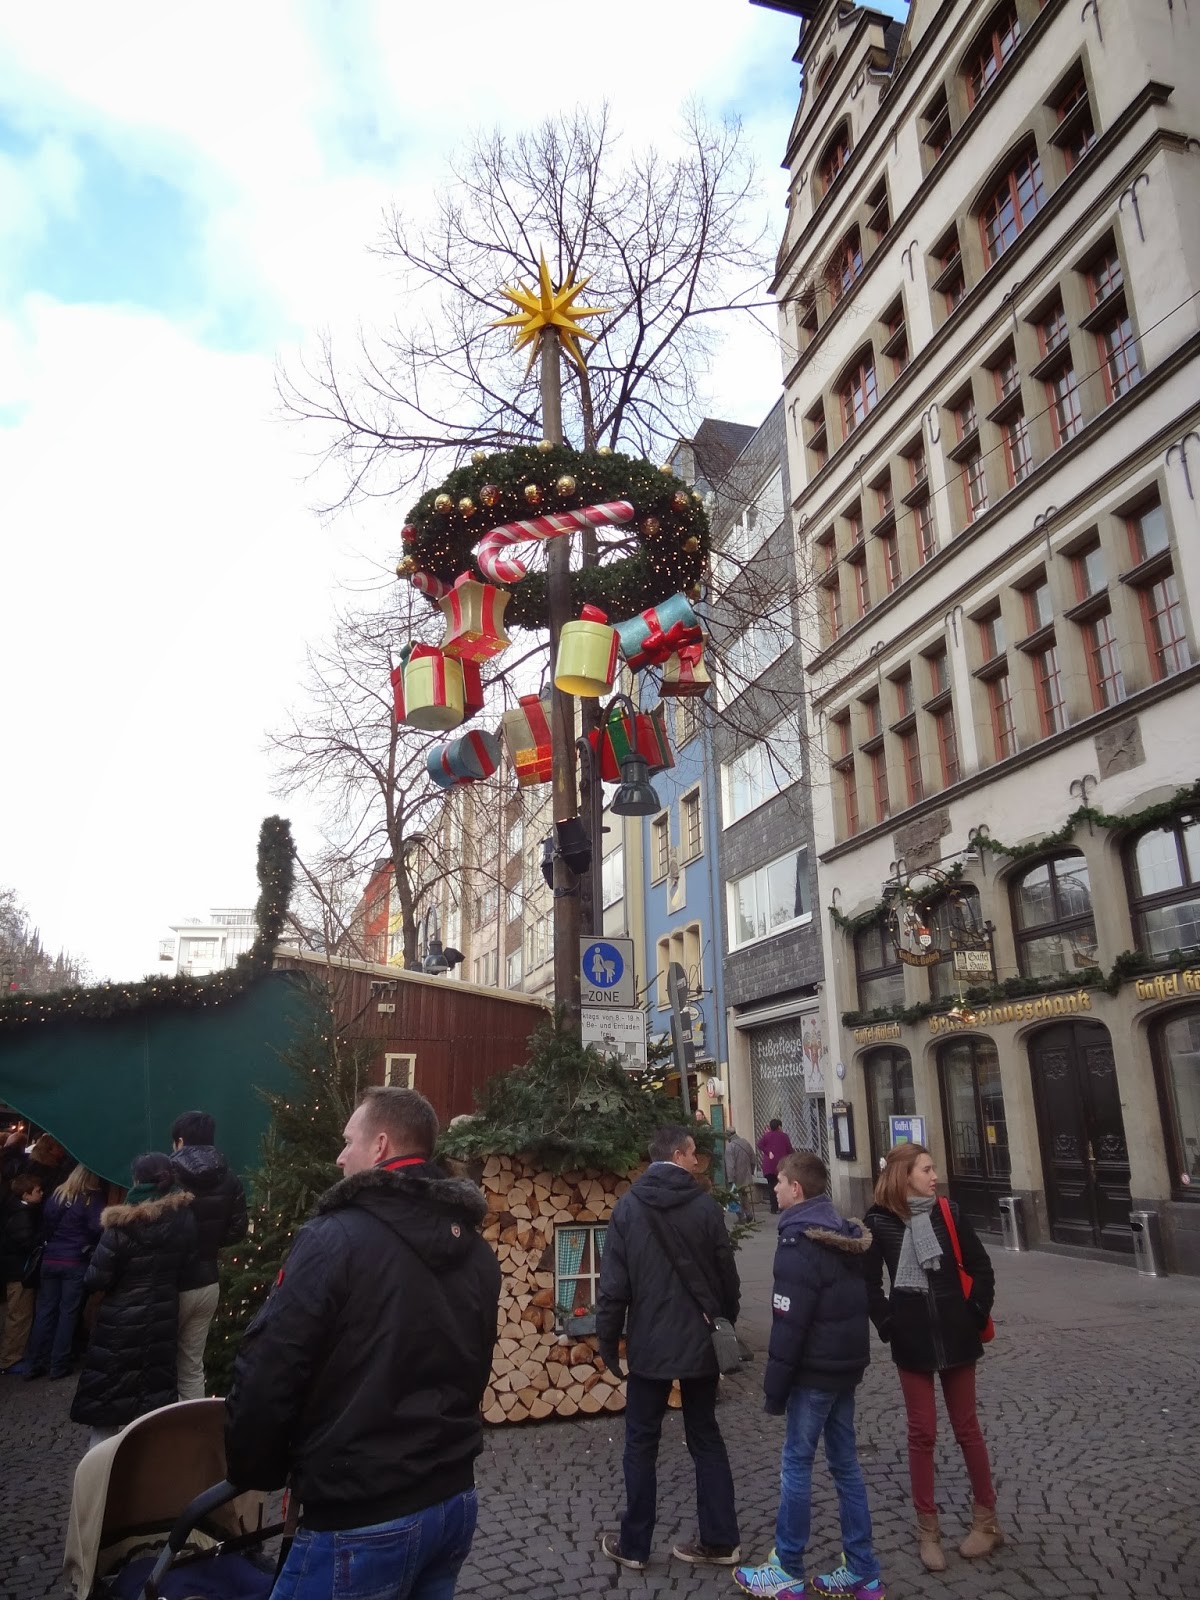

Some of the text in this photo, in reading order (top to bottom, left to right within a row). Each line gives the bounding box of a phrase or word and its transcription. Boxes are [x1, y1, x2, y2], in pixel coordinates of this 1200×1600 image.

[588, 990, 620, 1003] ZONE
[1135, 973, 1181, 1000] Gaffel
[928, 989, 1092, 1034] Braeiausschank
[613, 1023, 640, 1031] Entladen
[854, 1022, 901, 1044] Gaffel-Kölsch
[757, 1036, 802, 1060] Fußpflege
[895, 1120, 909, 1132] Gaffel
[773, 1293, 791, 1312] 58
